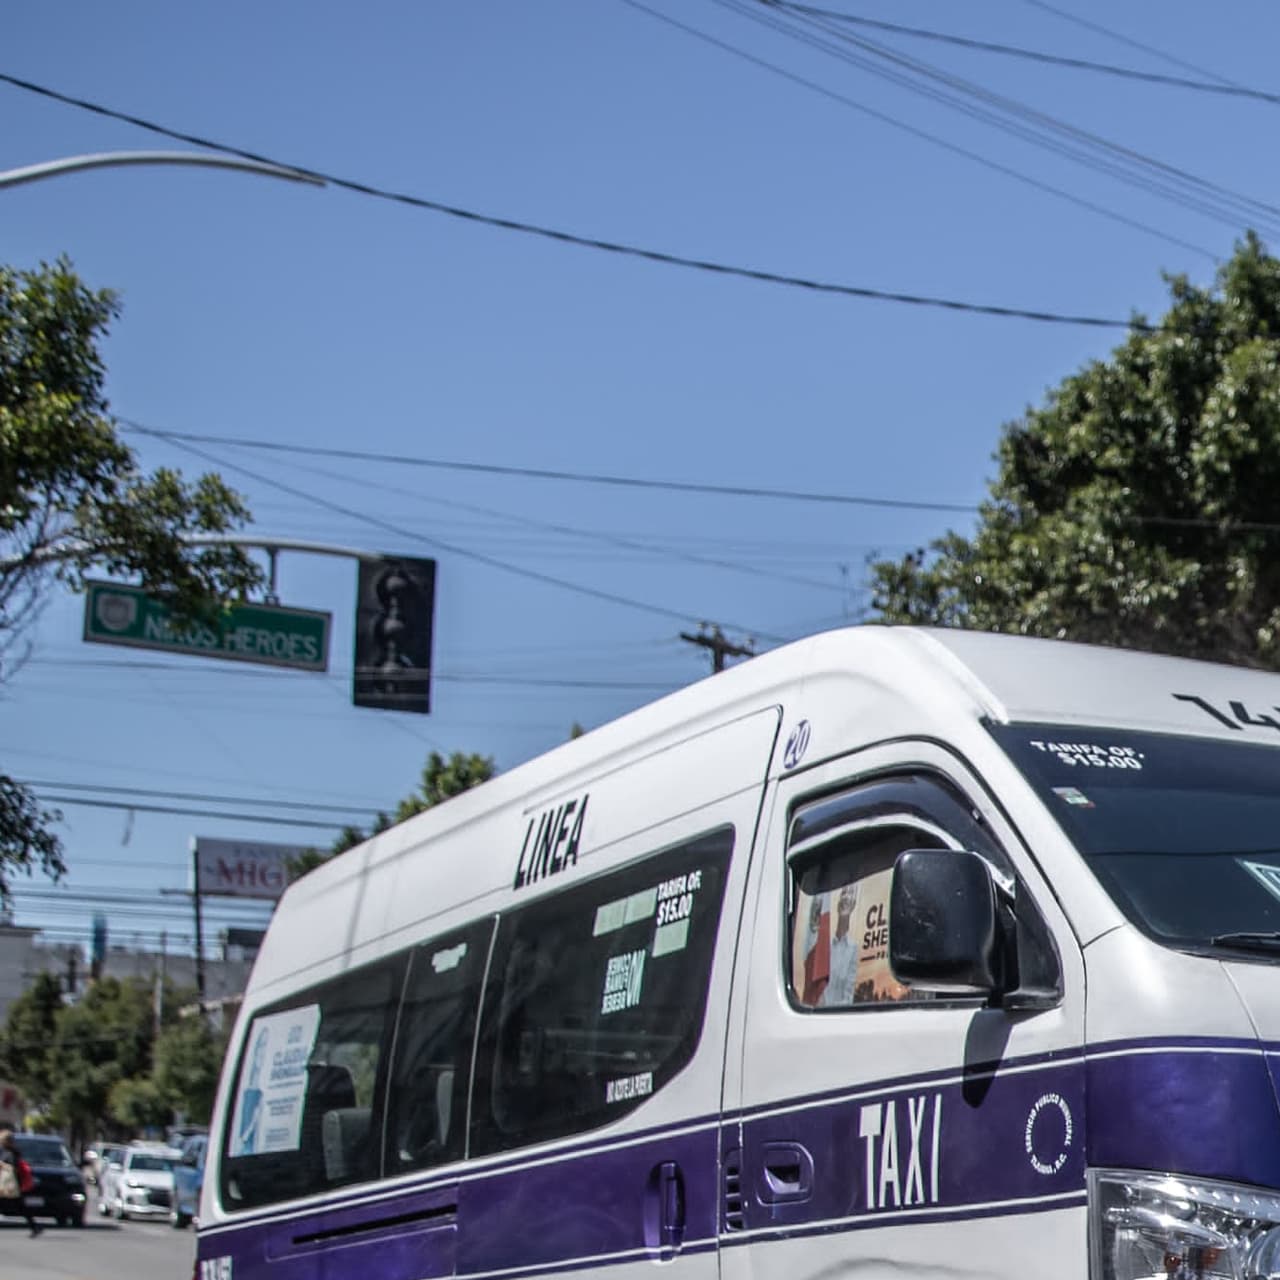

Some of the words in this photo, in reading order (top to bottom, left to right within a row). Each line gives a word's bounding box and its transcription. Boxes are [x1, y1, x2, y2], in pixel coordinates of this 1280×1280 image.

[223, 627, 319, 660] HEROES
[1029, 740, 1109, 756] TARIFA
[1057, 752, 1143, 769] $15.00
[513, 793, 589, 891] LINEA
[858, 1093, 942, 1208] TAXI
